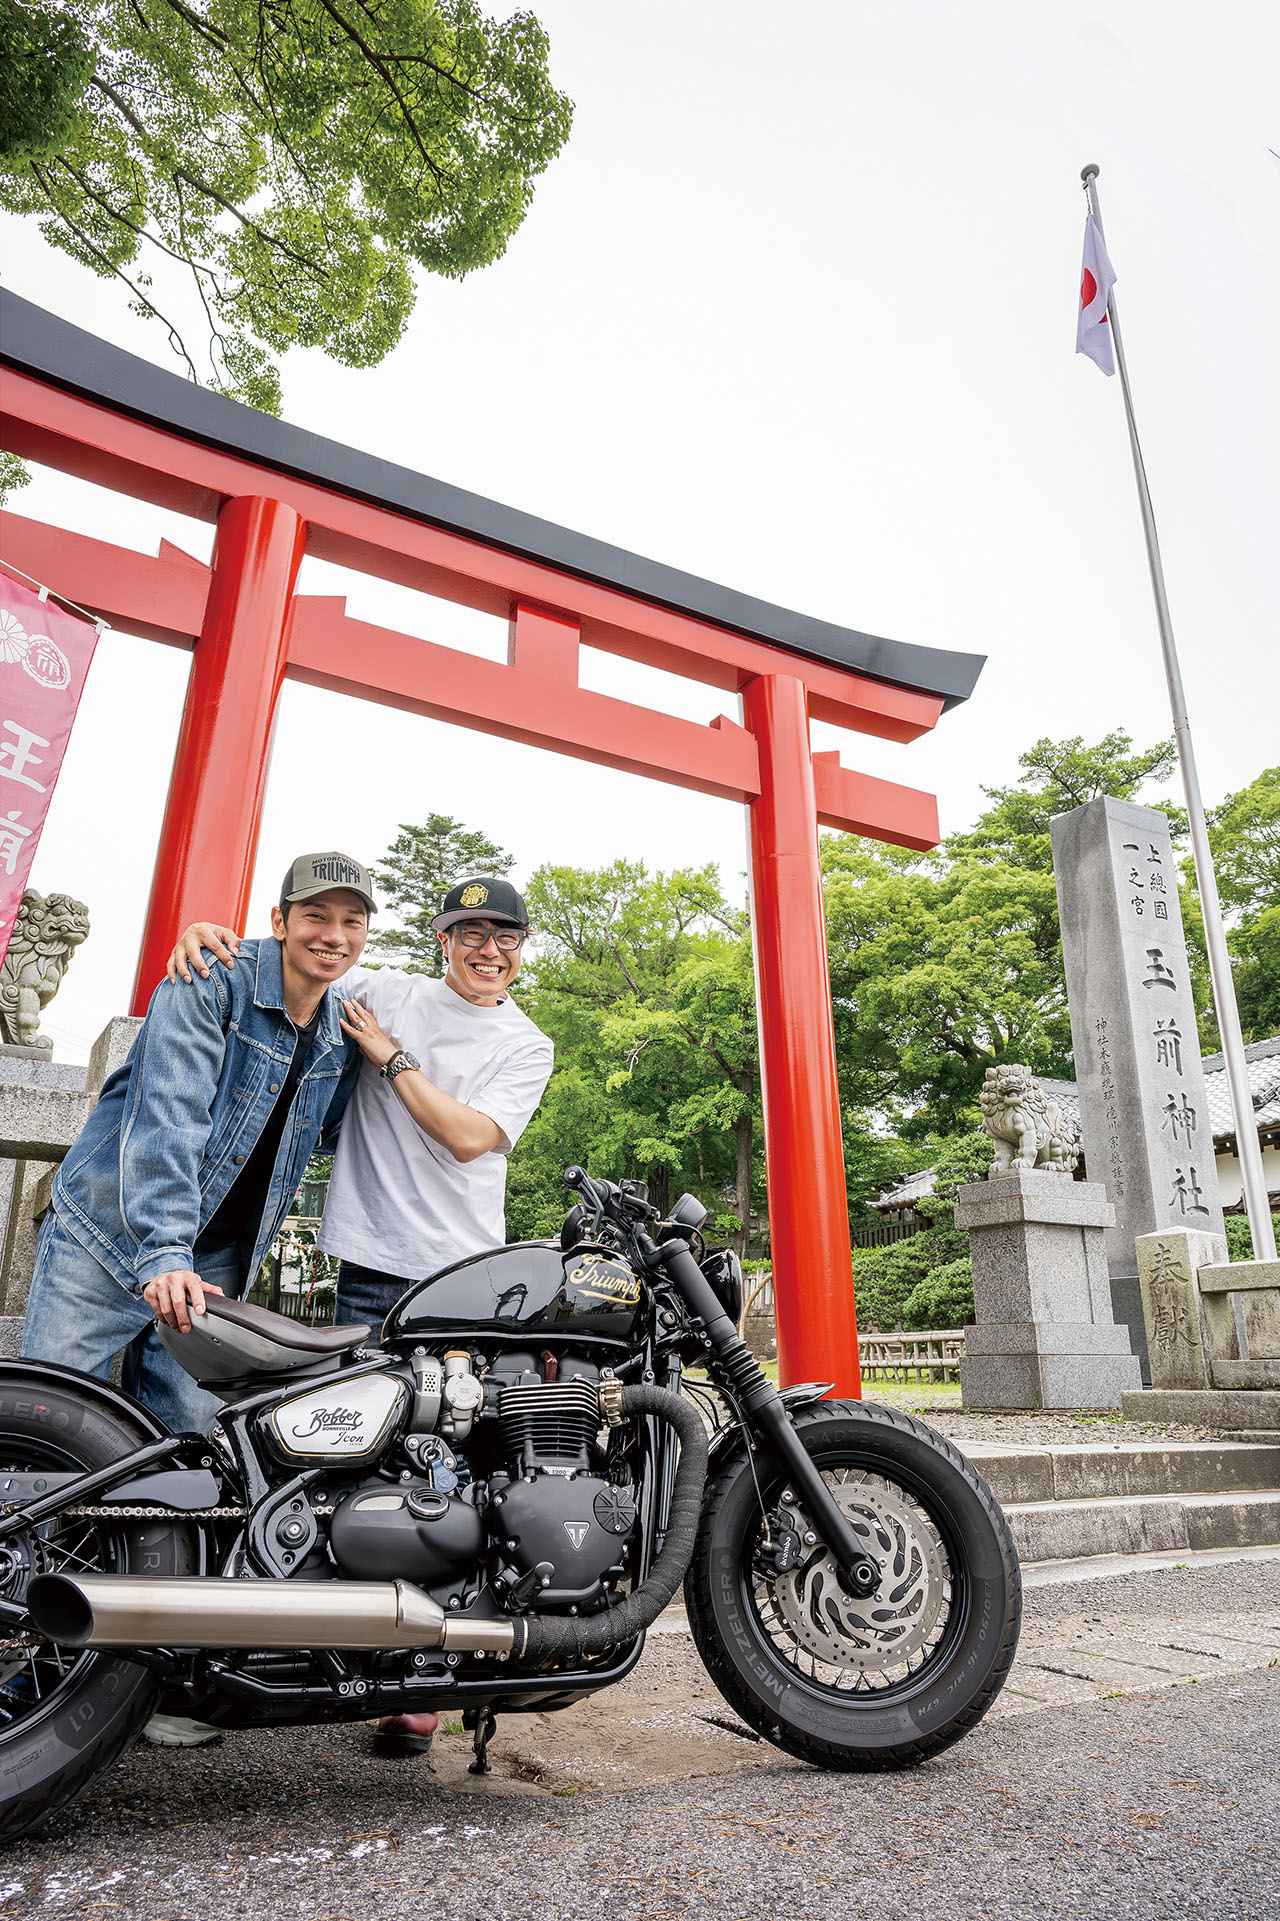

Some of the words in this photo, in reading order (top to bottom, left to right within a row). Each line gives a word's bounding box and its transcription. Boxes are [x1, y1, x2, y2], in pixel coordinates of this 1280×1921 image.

[311, 856, 360, 872] MOTORCYC
[311, 861, 361, 883] TRIUMPH
[1142, 948, 1210, 1216] 玉前神社
[569, 1253, 641, 1303] Triumph
[292, 1407, 364, 1438] Bobber
[330, 1431, 364, 1445] Icon
[780, 1536, 792, 1566] brembo
[720, 1572, 786, 1697] METZELER
